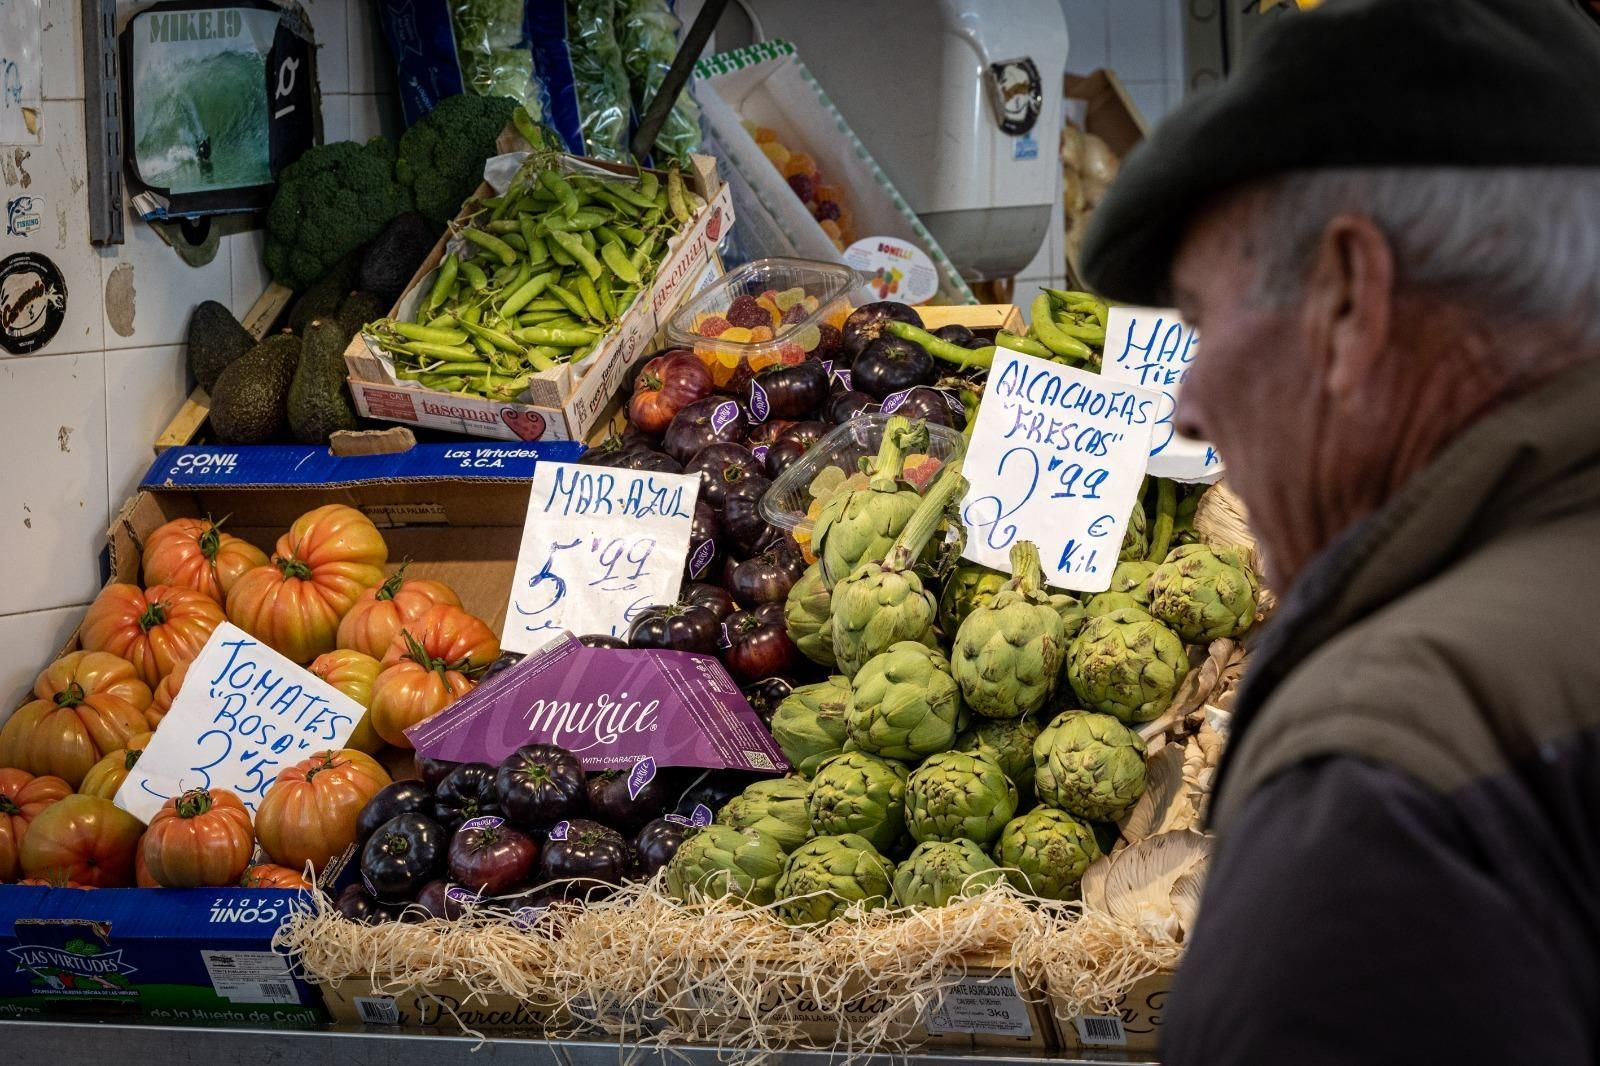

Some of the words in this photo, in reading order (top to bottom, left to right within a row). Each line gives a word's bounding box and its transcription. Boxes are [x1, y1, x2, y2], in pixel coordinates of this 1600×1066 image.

[996, 360, 1153, 425] ALCACHOFAS
[421, 399, 499, 424] tasemar
[176, 453, 239, 467] CONIL
[444, 449, 472, 459] Las
[475, 448, 540, 459] Virtudes,
[459, 459, 505, 468] S.C.A.
[1088, 515, 1115, 537] €
[210, 640, 353, 741] TOMATES
[603, 755, 647, 764] CHARACTER
[209, 908, 278, 923] CONIL
[23, 951, 48, 965] LAS
[48, 952, 118, 973] VIRTUDES
[274, 1010, 316, 1024] Conil
[413, 994, 551, 1026] Parcela
[986, 1008, 1010, 1019] 3kg
